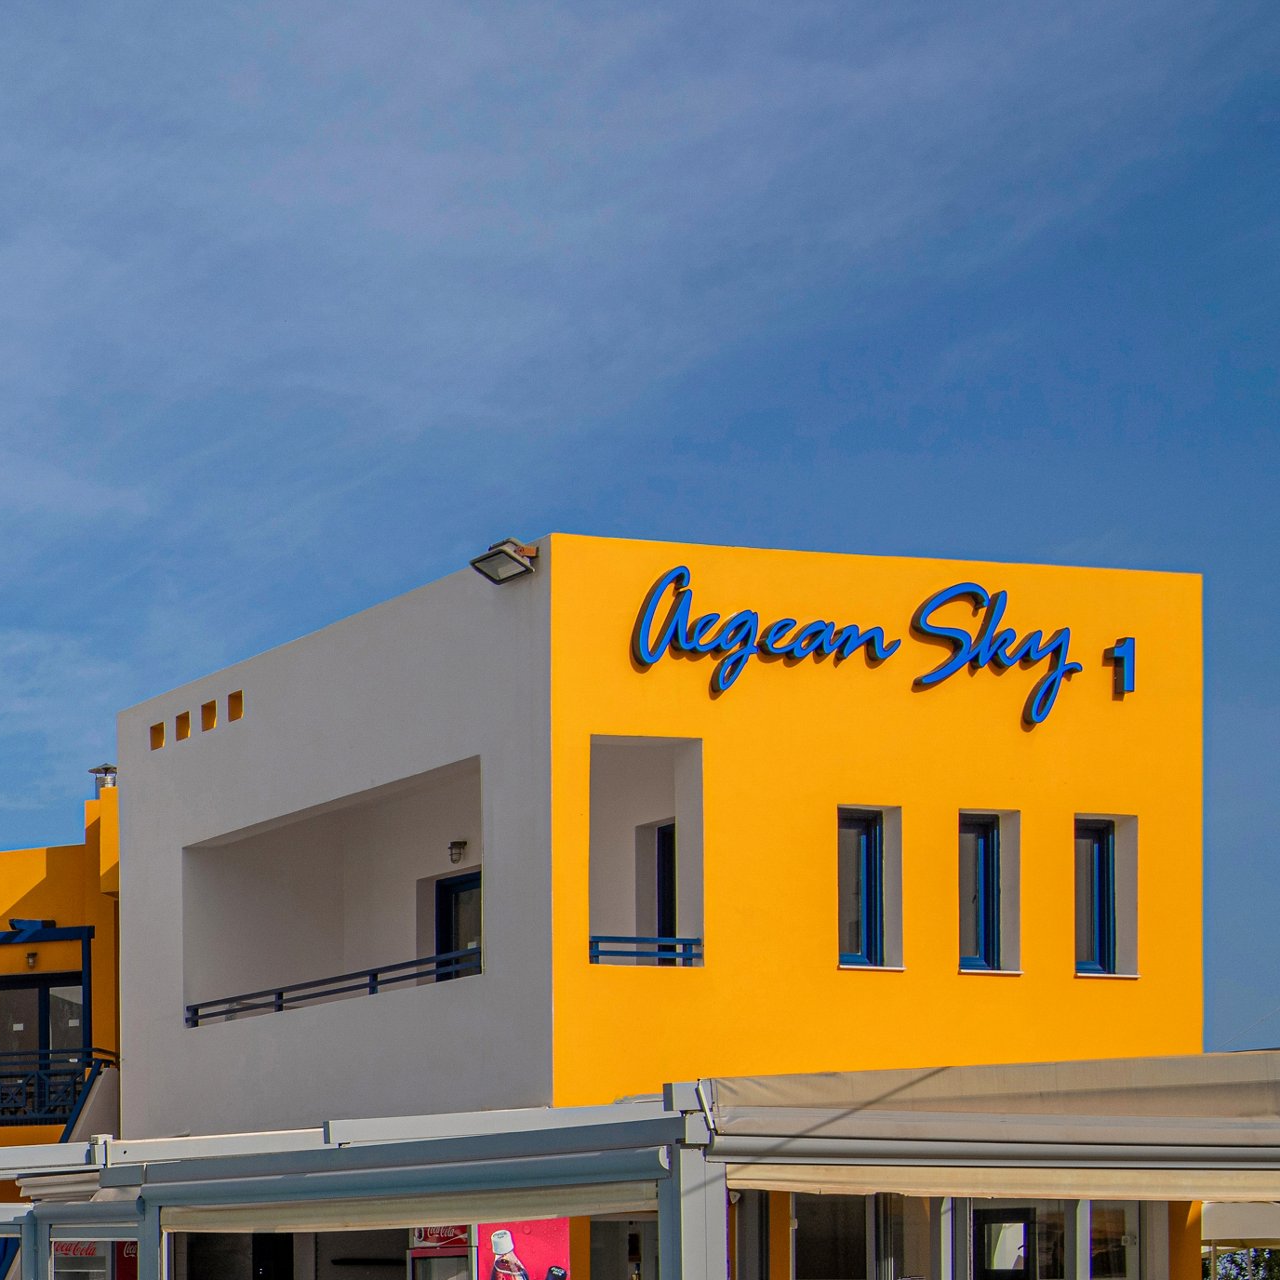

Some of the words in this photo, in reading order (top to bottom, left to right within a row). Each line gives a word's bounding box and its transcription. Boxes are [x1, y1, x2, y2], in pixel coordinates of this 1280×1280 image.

[632, 565, 902, 696] Aegean
[911, 581, 1084, 726] Sky
[1103, 636, 1136, 695] 1
